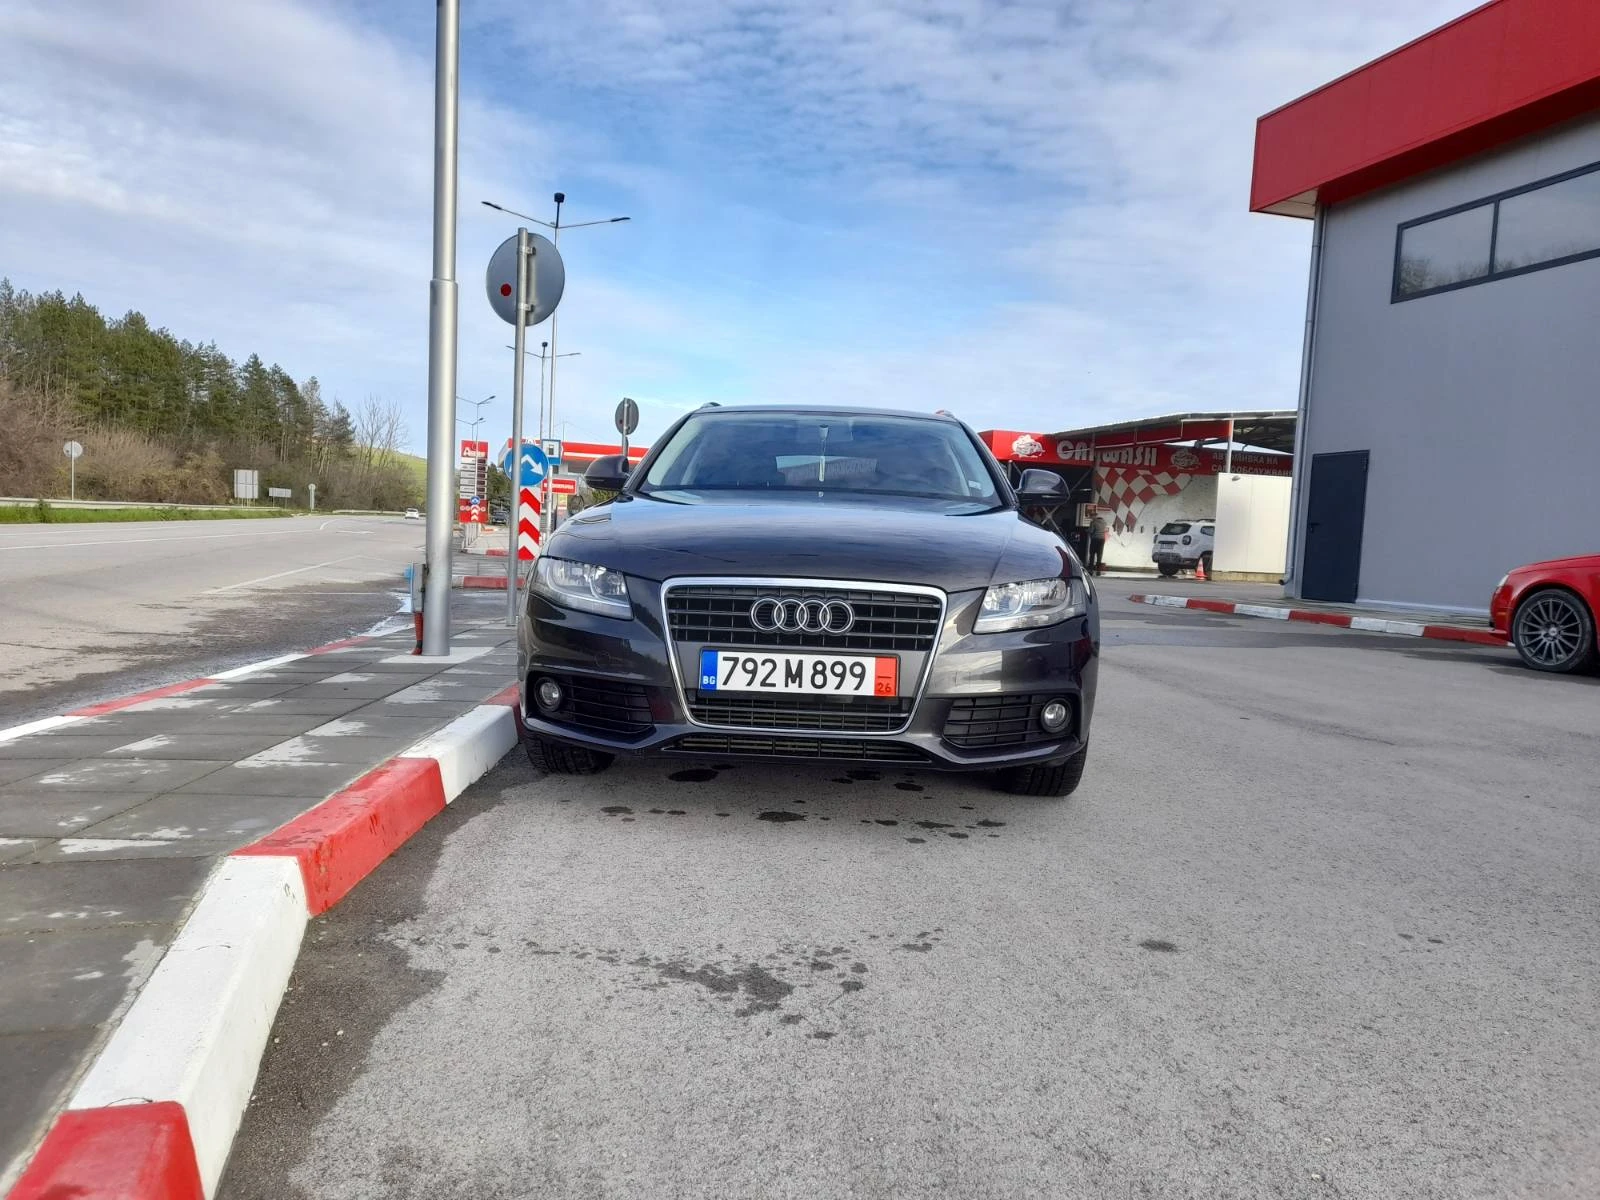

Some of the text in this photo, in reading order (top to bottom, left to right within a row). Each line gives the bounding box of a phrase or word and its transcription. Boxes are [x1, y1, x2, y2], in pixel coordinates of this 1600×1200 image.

[1212, 453, 1264, 463] АВОМИВКА
[702, 656, 892, 693] BG 792 M 899 26
